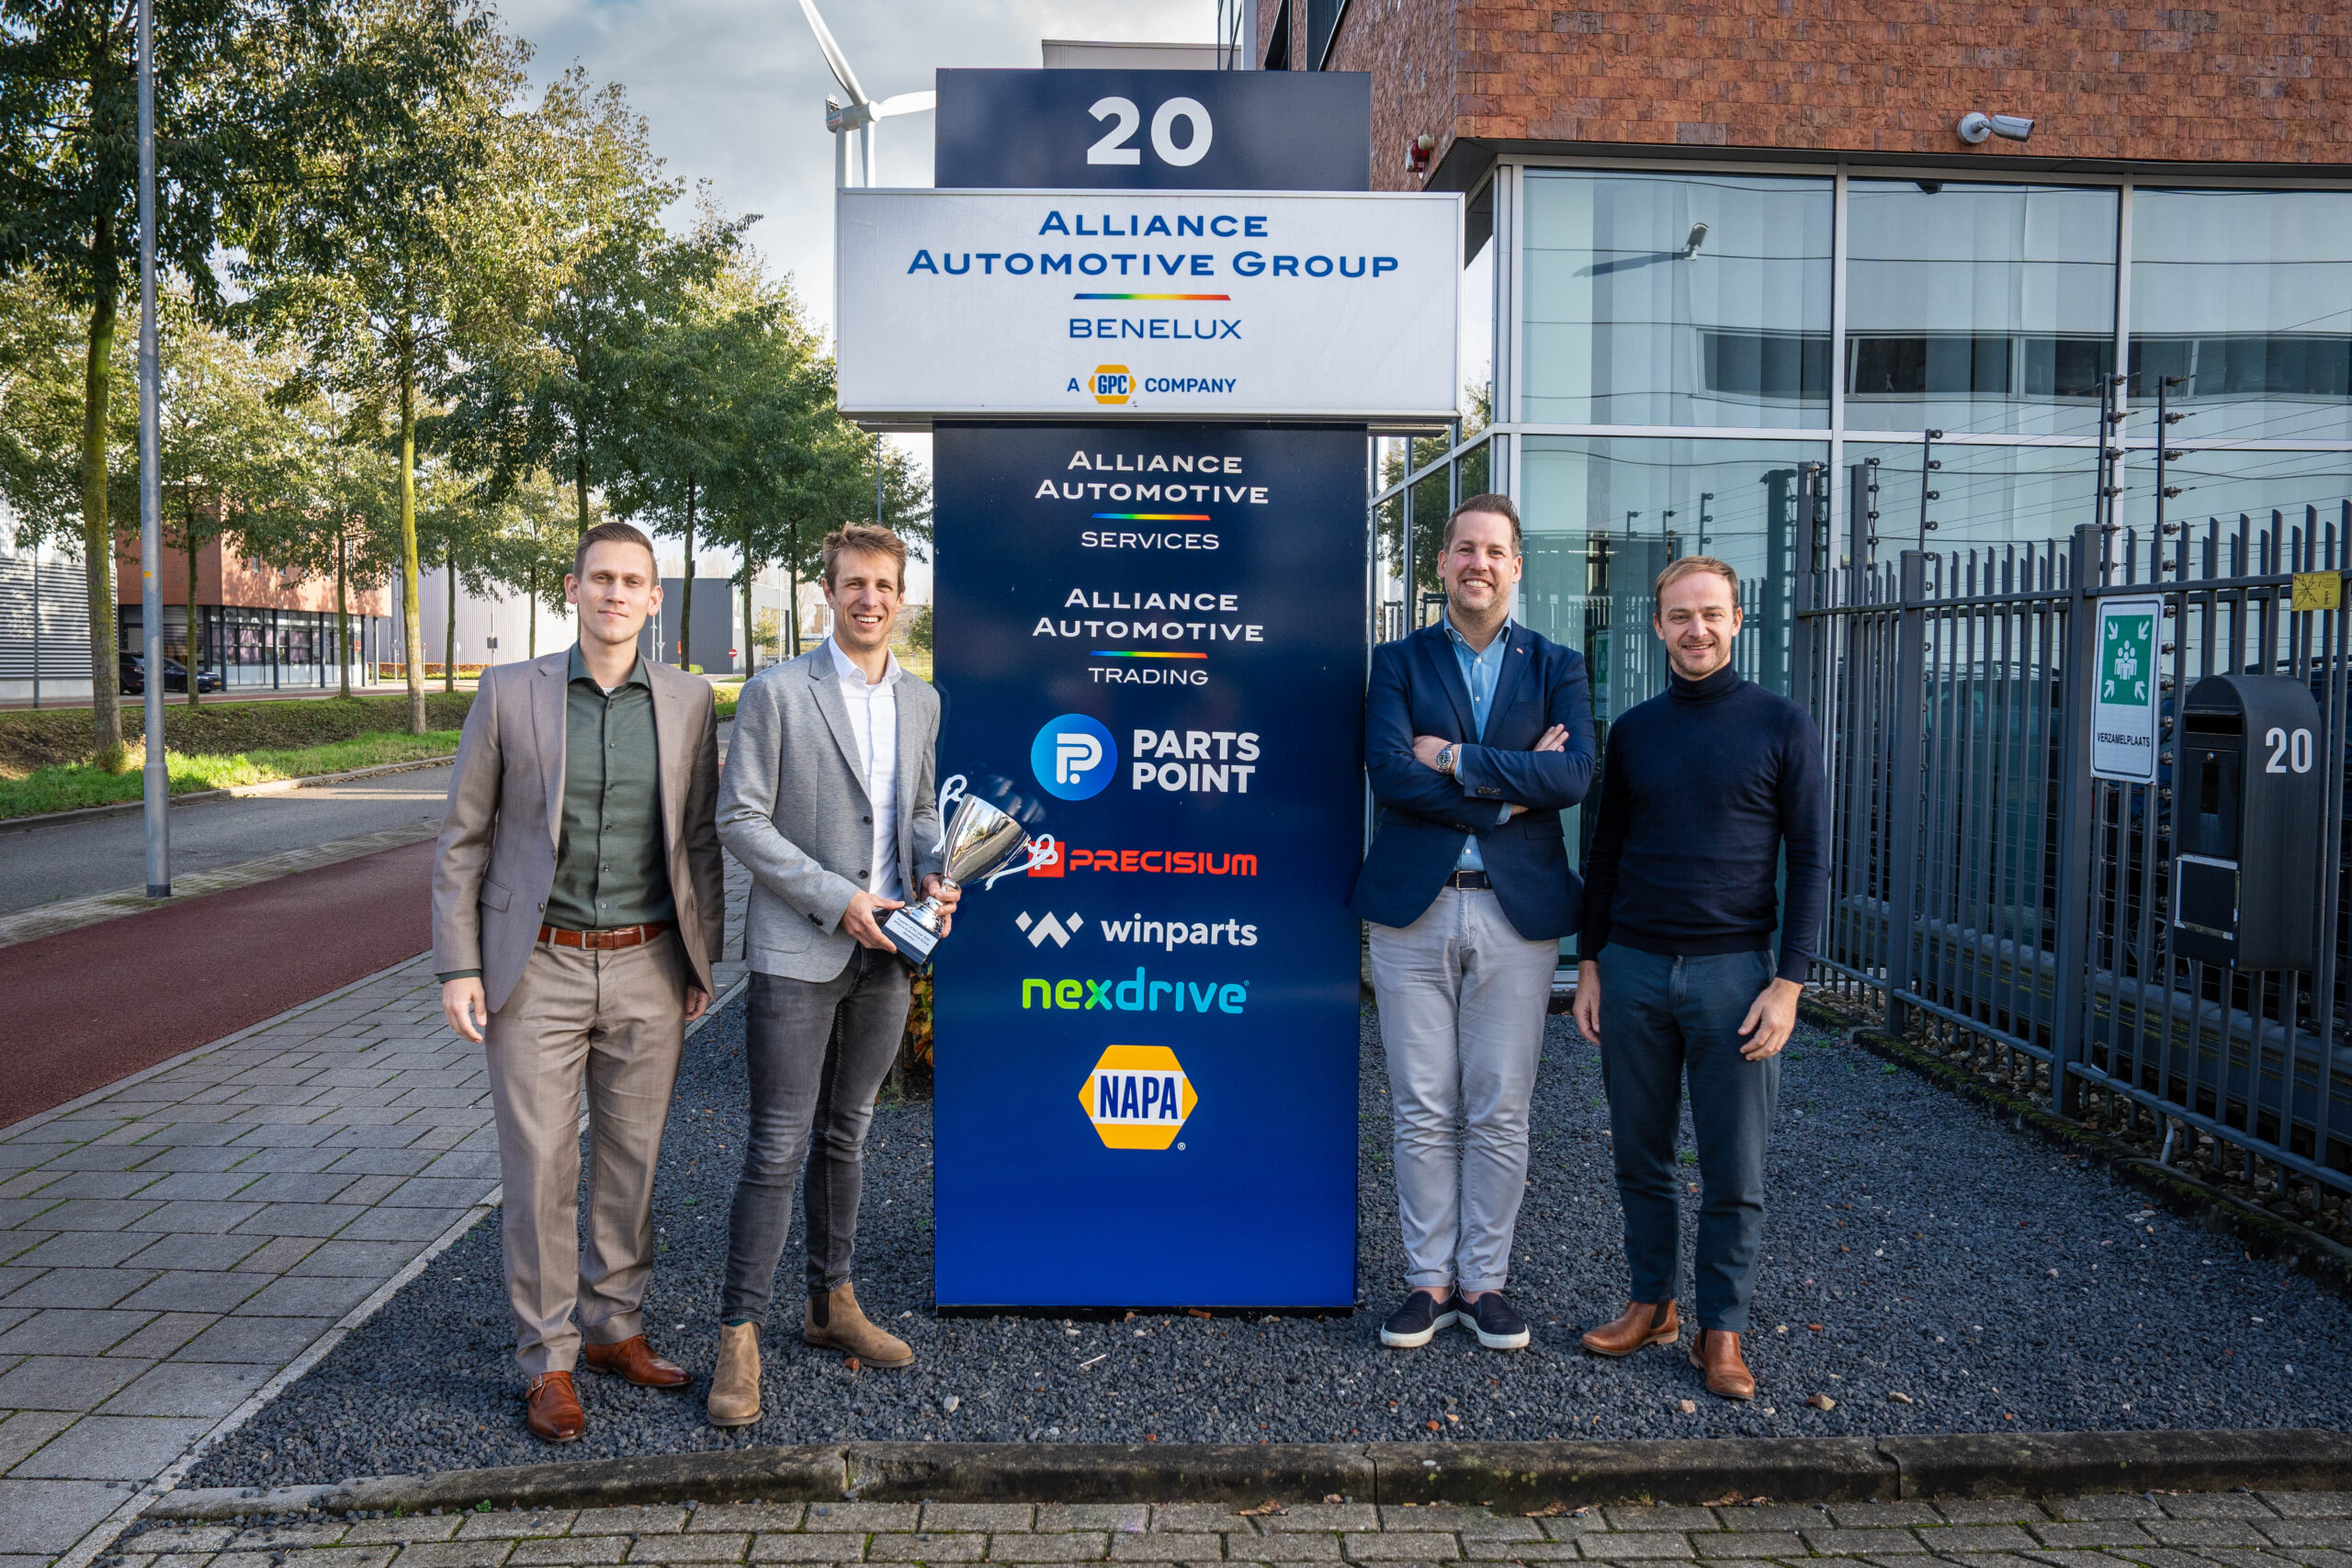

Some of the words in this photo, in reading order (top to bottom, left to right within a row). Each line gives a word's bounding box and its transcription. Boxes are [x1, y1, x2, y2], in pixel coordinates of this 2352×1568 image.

[1087, 96, 1213, 166] 20
[1039, 211, 1267, 237] ALLIANCE
[908, 250, 1214, 276] AUTOMOTIVE
[1233, 252, 1397, 277] GROUP
[1070, 319, 1241, 339] BENELUX
[1067, 378, 1080, 392] A
[1098, 376, 1127, 394] GPC
[1145, 378, 1237, 392] COMPANY
[1068, 451, 1242, 473] ALLIANCE
[1035, 479, 1268, 503] AUTOMOTIVE
[1081, 532, 1219, 550] SERVICES
[1065, 589, 1238, 611] ALLIANCE
[1033, 617, 1263, 641] AUTOMOTIVE
[1089, 668, 1208, 685] TRADING
[1134, 729, 1260, 761] PARTS
[2097, 732, 2151, 748] VERZAMELPLAATS
[2265, 728, 2312, 773] 20
[1133, 762, 1255, 794] POINT
[1069, 850, 1257, 876] PRECISIUM
[1101, 913, 1258, 952] winparts
[1100, 1076, 1179, 1119] NAPA
